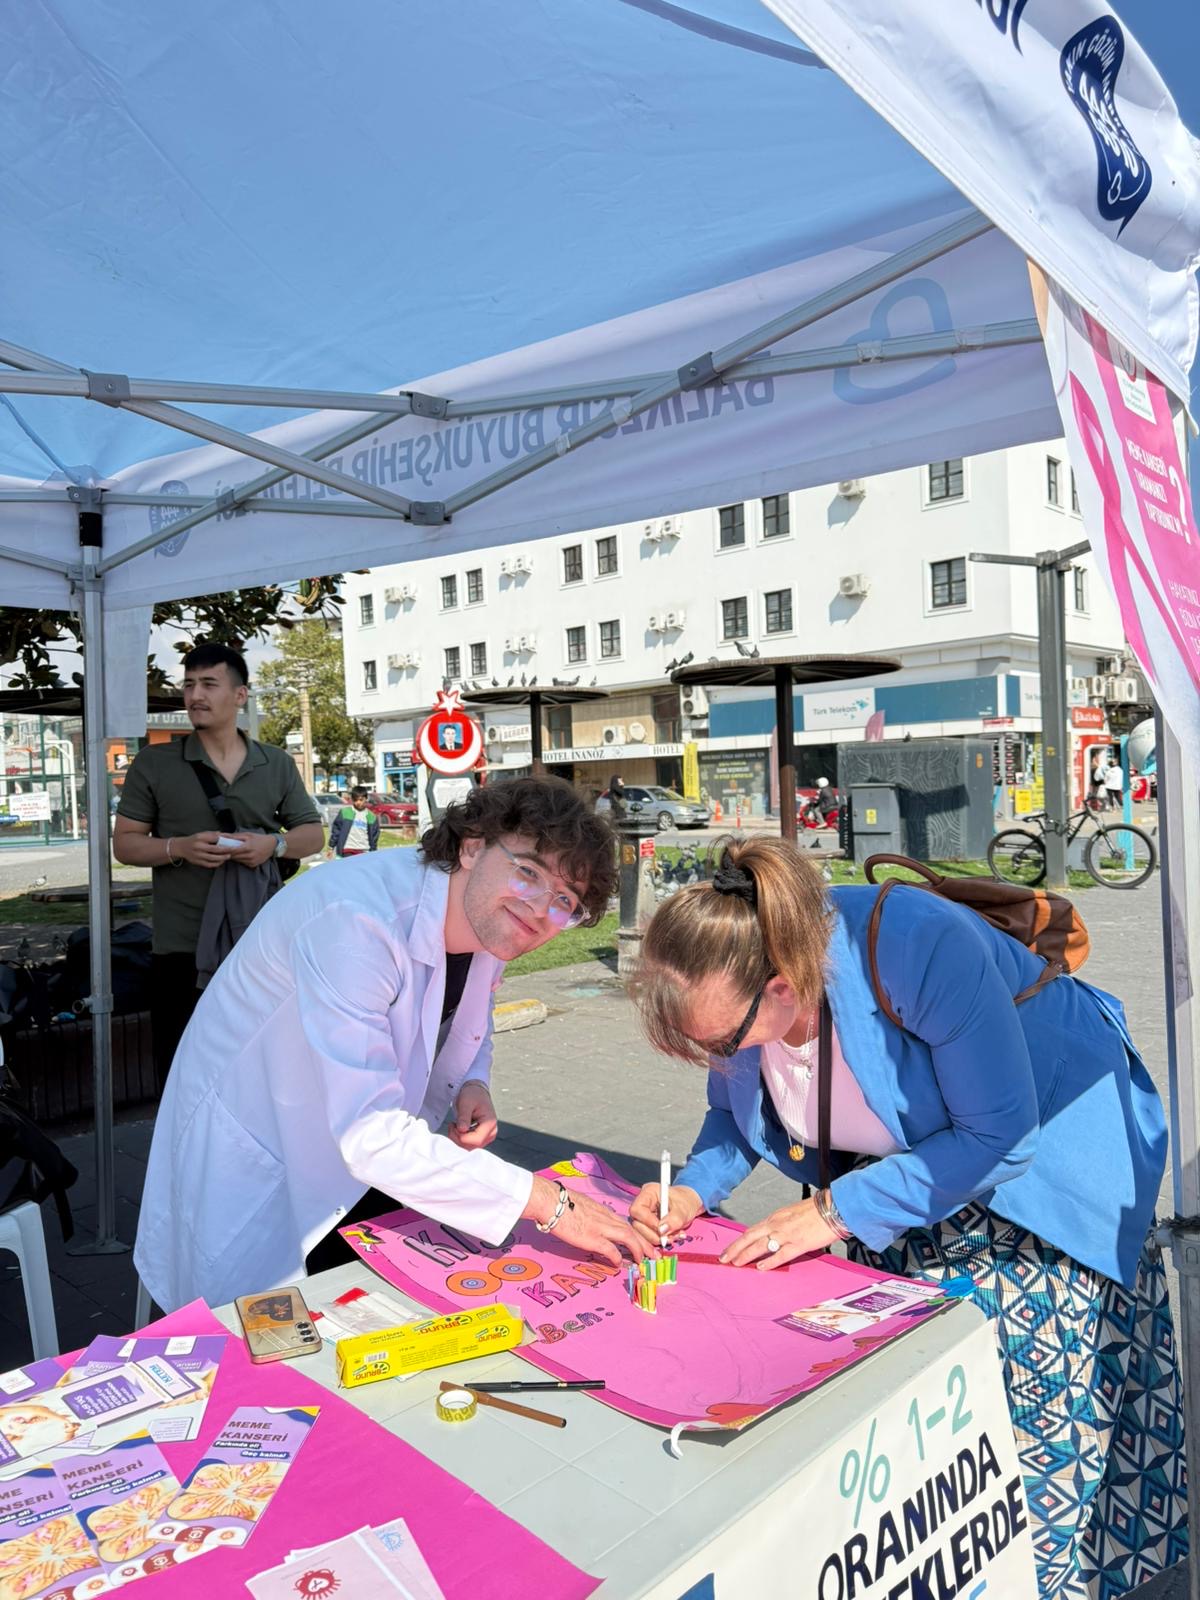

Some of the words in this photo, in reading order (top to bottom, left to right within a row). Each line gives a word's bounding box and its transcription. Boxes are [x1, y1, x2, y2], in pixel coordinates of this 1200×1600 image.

[653, 745, 682, 755] HOTEL
[419, 1320, 461, 1335] BRUNO
[228, 1421, 272, 1430] MEME
[220, 1431, 288, 1442] KANSERİ
[840, 1417, 891, 1529] %
[908, 1364, 973, 1461] 1-2
[62, 1459, 113, 1481] MEME
[67, 1459, 144, 1492] KANSERİ
[818, 1431, 1002, 1600] ORANINDA
